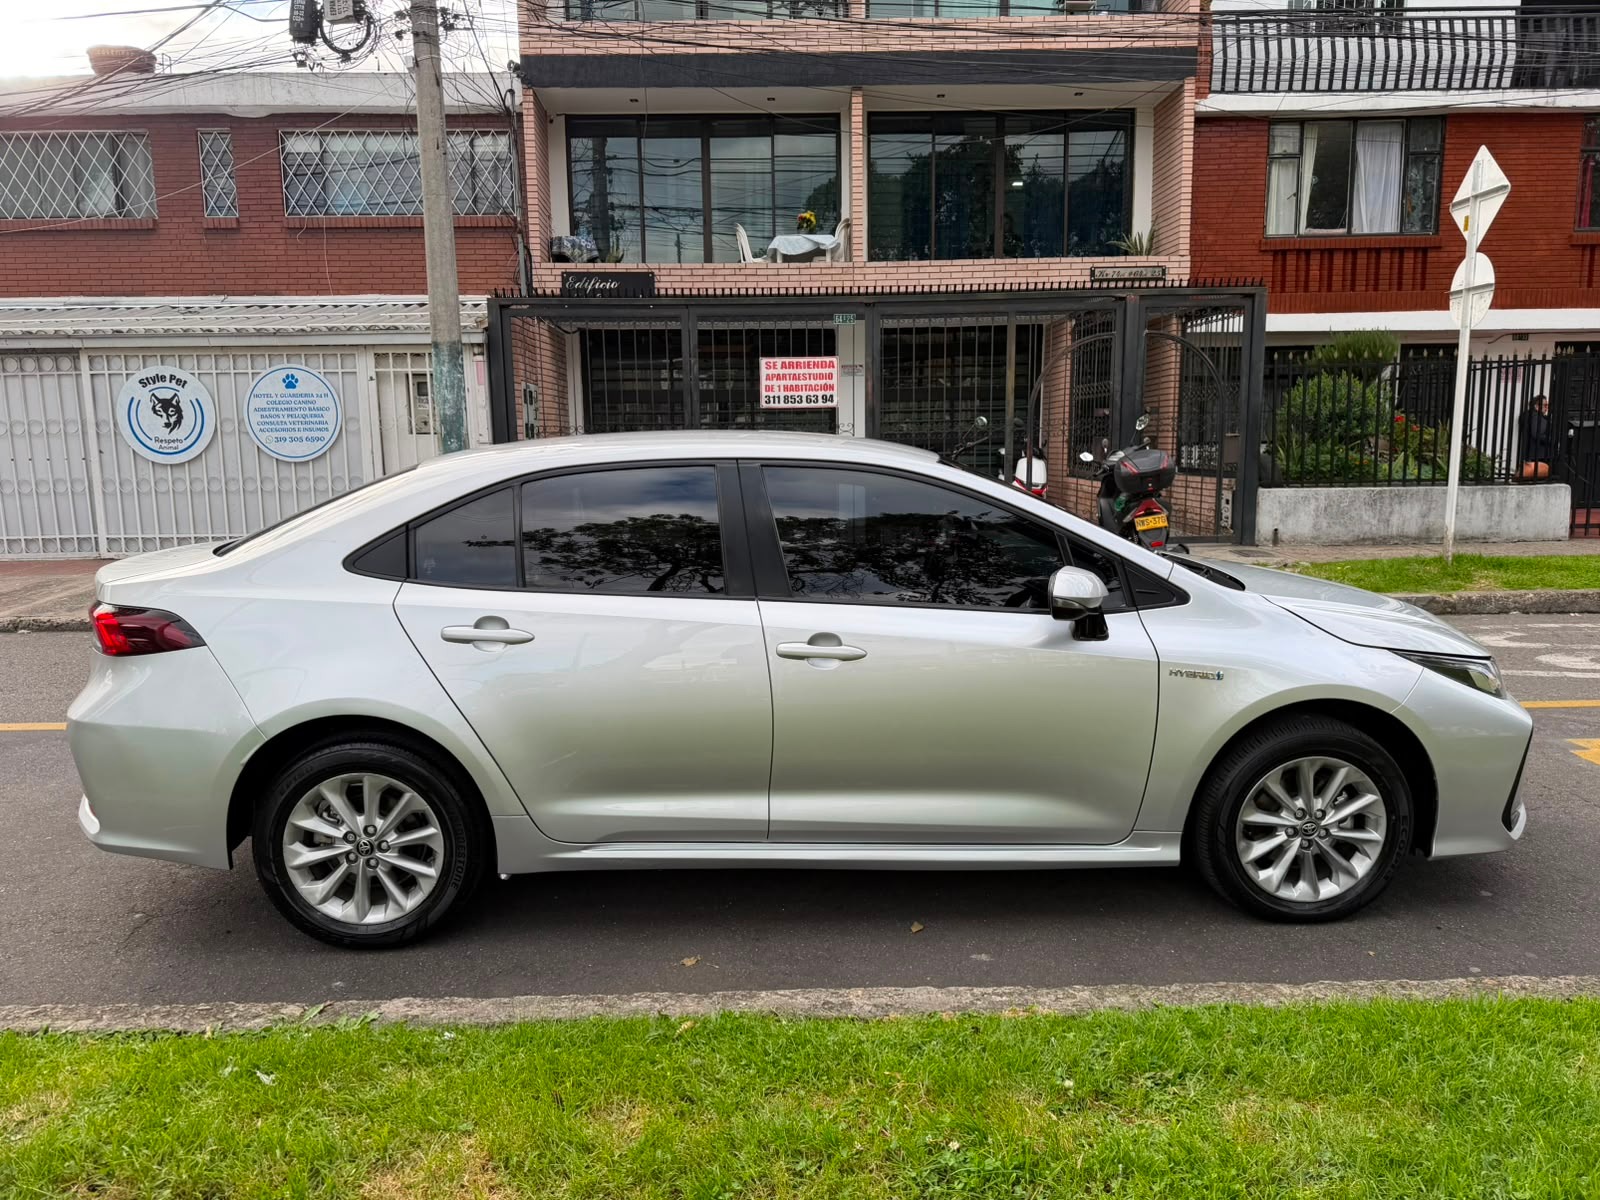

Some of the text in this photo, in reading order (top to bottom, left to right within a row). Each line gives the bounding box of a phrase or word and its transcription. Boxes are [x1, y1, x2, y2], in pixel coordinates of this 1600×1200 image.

[565, 275, 621, 294] Edificio
[765, 361, 778, 370] SE
[780, 360, 835, 370] ARRIENDA
[138, 373, 188, 389] Style Pet
[765, 372, 834, 381] APARTAESTUDIO
[765, 383, 835, 392] DE 1 HABITACIÓN
[764, 394, 834, 404] 311 853 63 94
[154, 436, 184, 445] Respeto
[305, 435, 326, 443] 6590
[1168, 668, 1216, 680] HYBRID
[449, 807, 467, 889] IDGESTONE
